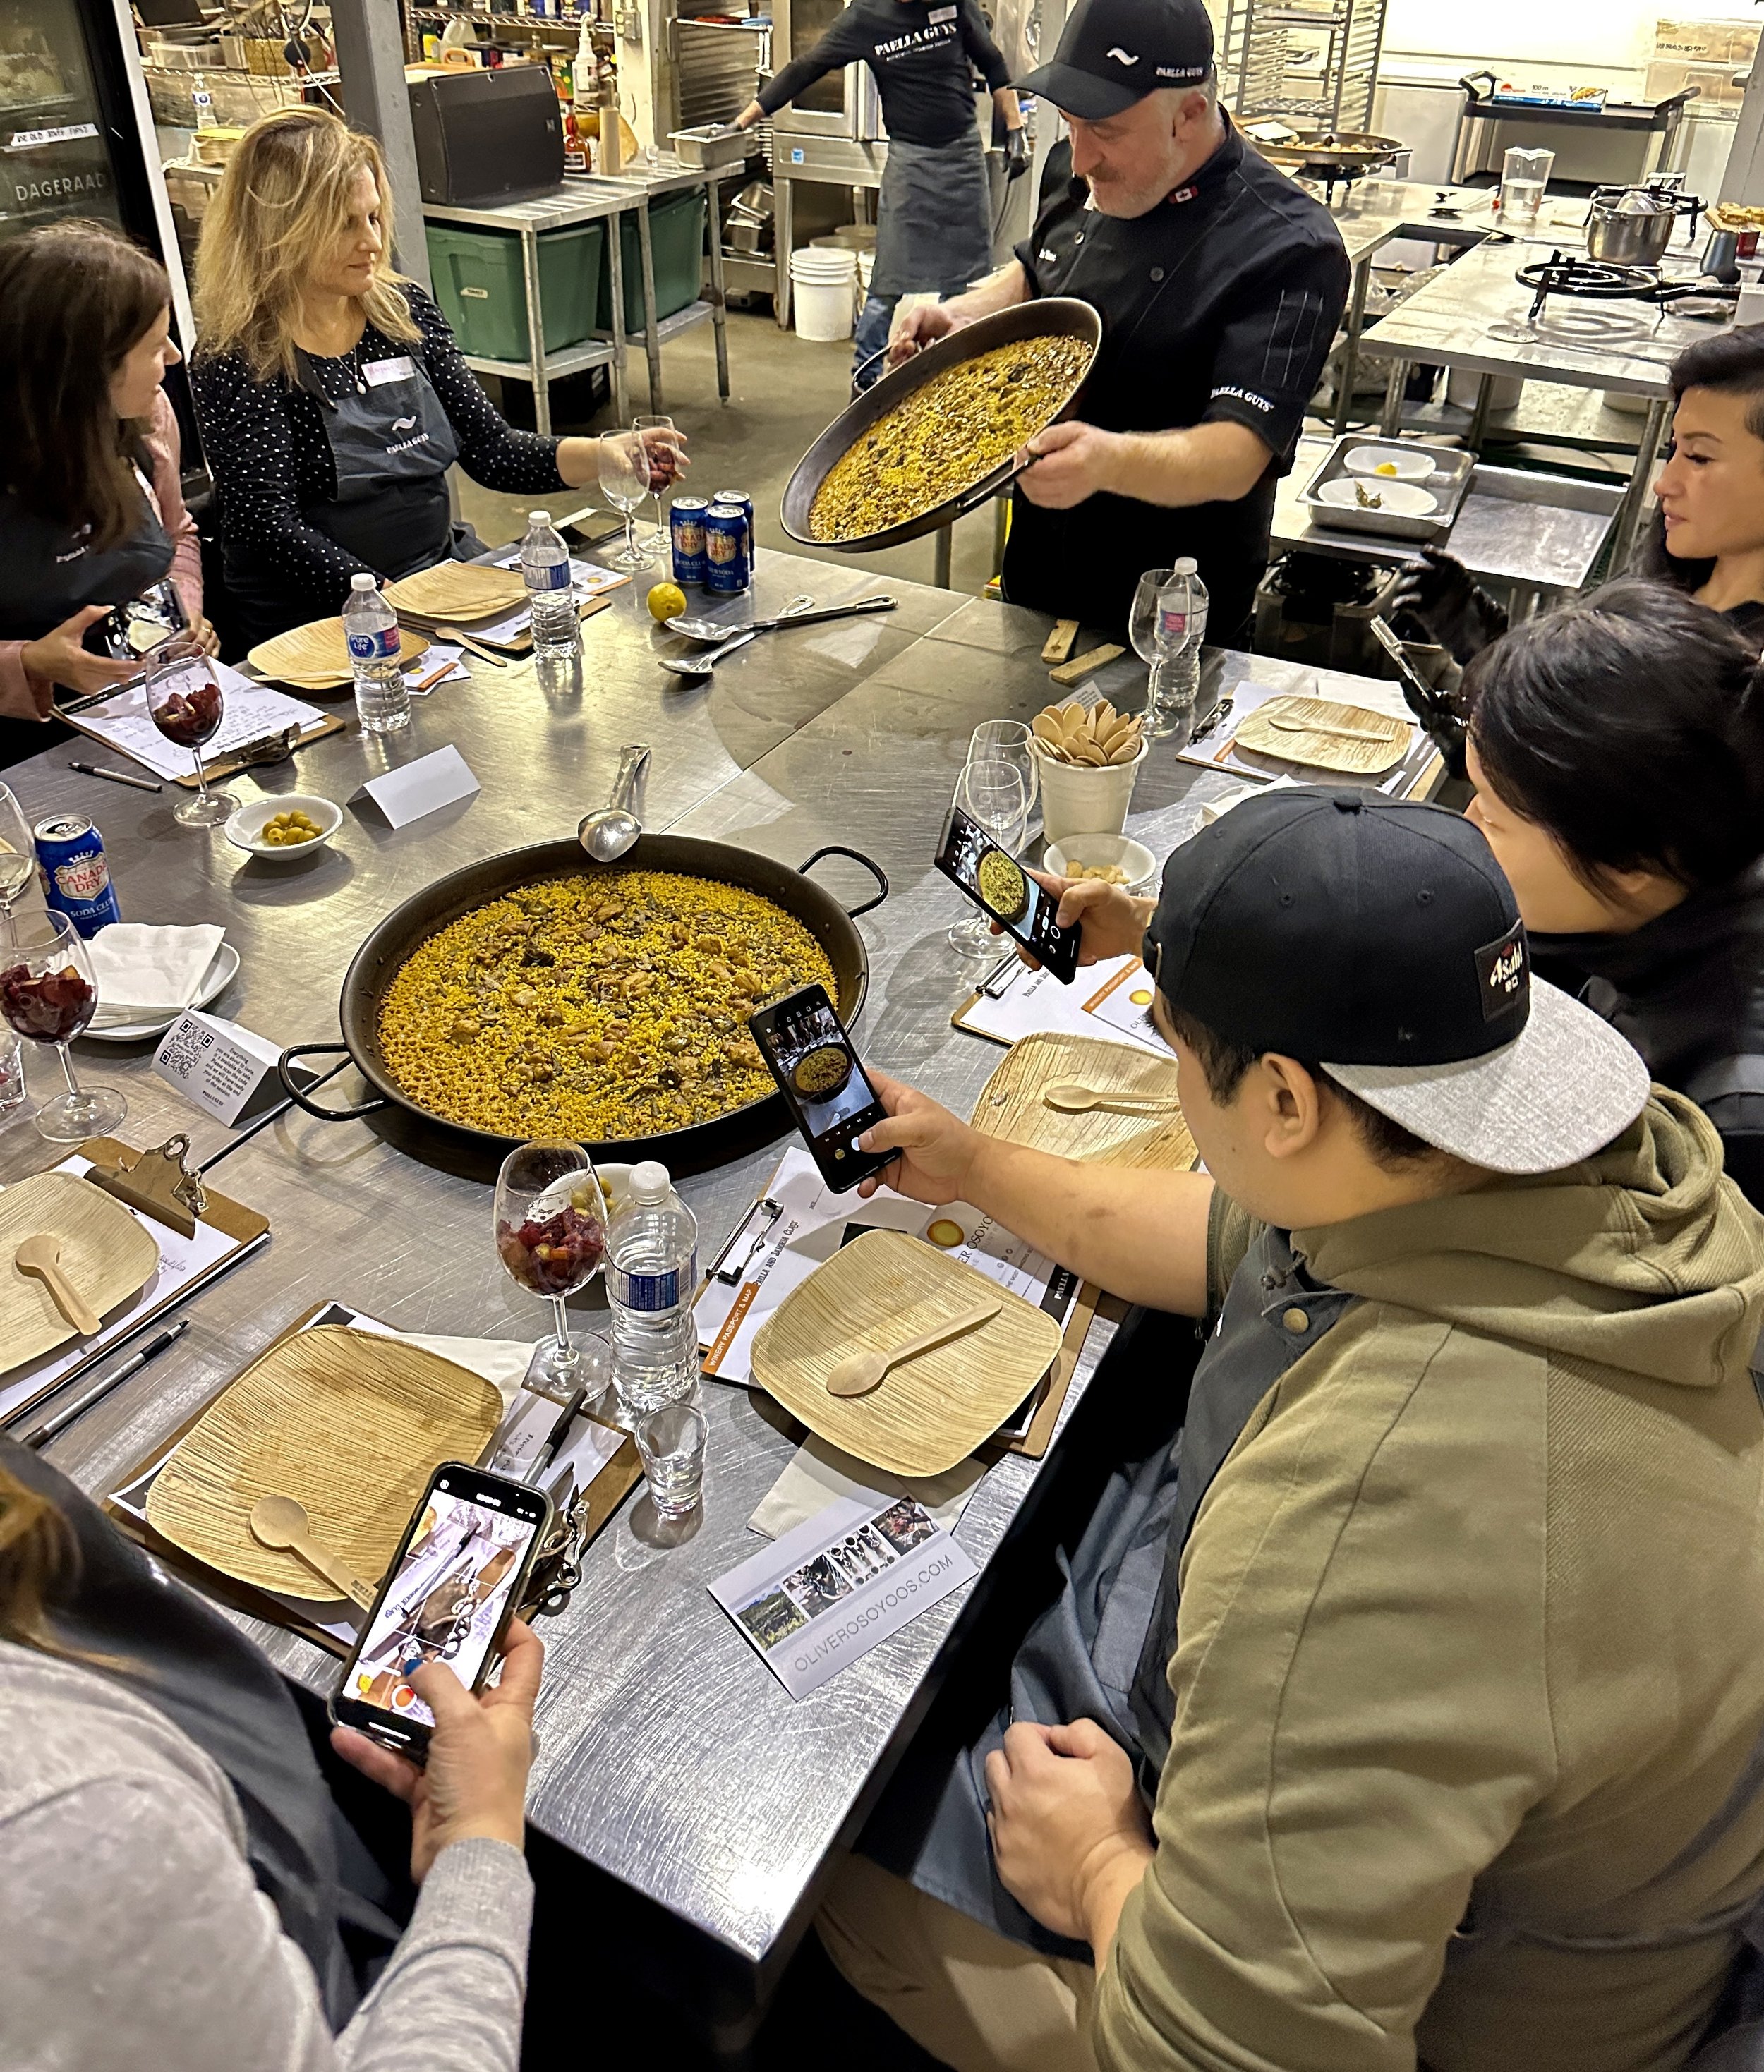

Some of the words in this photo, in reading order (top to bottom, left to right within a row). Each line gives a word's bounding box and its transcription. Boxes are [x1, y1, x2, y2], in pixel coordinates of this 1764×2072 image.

[874, 32, 922, 55] PAELLA
[923, 23, 957, 40] GUYS
[30, 132, 44, 141] OLD
[16, 173, 105, 201] DAGERAAD
[1210, 386, 1243, 399] PAELLA
[75, 876, 102, 892] DRY
[71, 907, 95, 917] SODA
[1490, 941, 1523, 987] Asahi
[1088, 990, 1106, 1007] WINERY
[1104, 971, 1126, 993] PASSPORT
[1129, 961, 1140, 971] MAP
[221, 1058, 236, 1070] available
[229, 1048, 248, 1064] Everything
[211, 1058, 223, 1069] Please
[223, 1067, 232, 1075] scan
[238, 1077, 247, 1086] code
[225, 1075, 234, 1084] have
[234, 1082, 244, 1092] ready
[783, 1220, 799, 1237] CLASS
[771, 1236, 789, 1257] SANGRIA
[766, 1256, 777, 1270] AND
[753, 1268, 770, 1286] PAELLA
[708, 1342, 725, 1367] WINERY
[722, 1306, 743, 1342] PASSPORT
[742, 1288, 752, 1303] MAP
[795, 1555, 953, 1671] OLIVEROSOYOOS.COM
